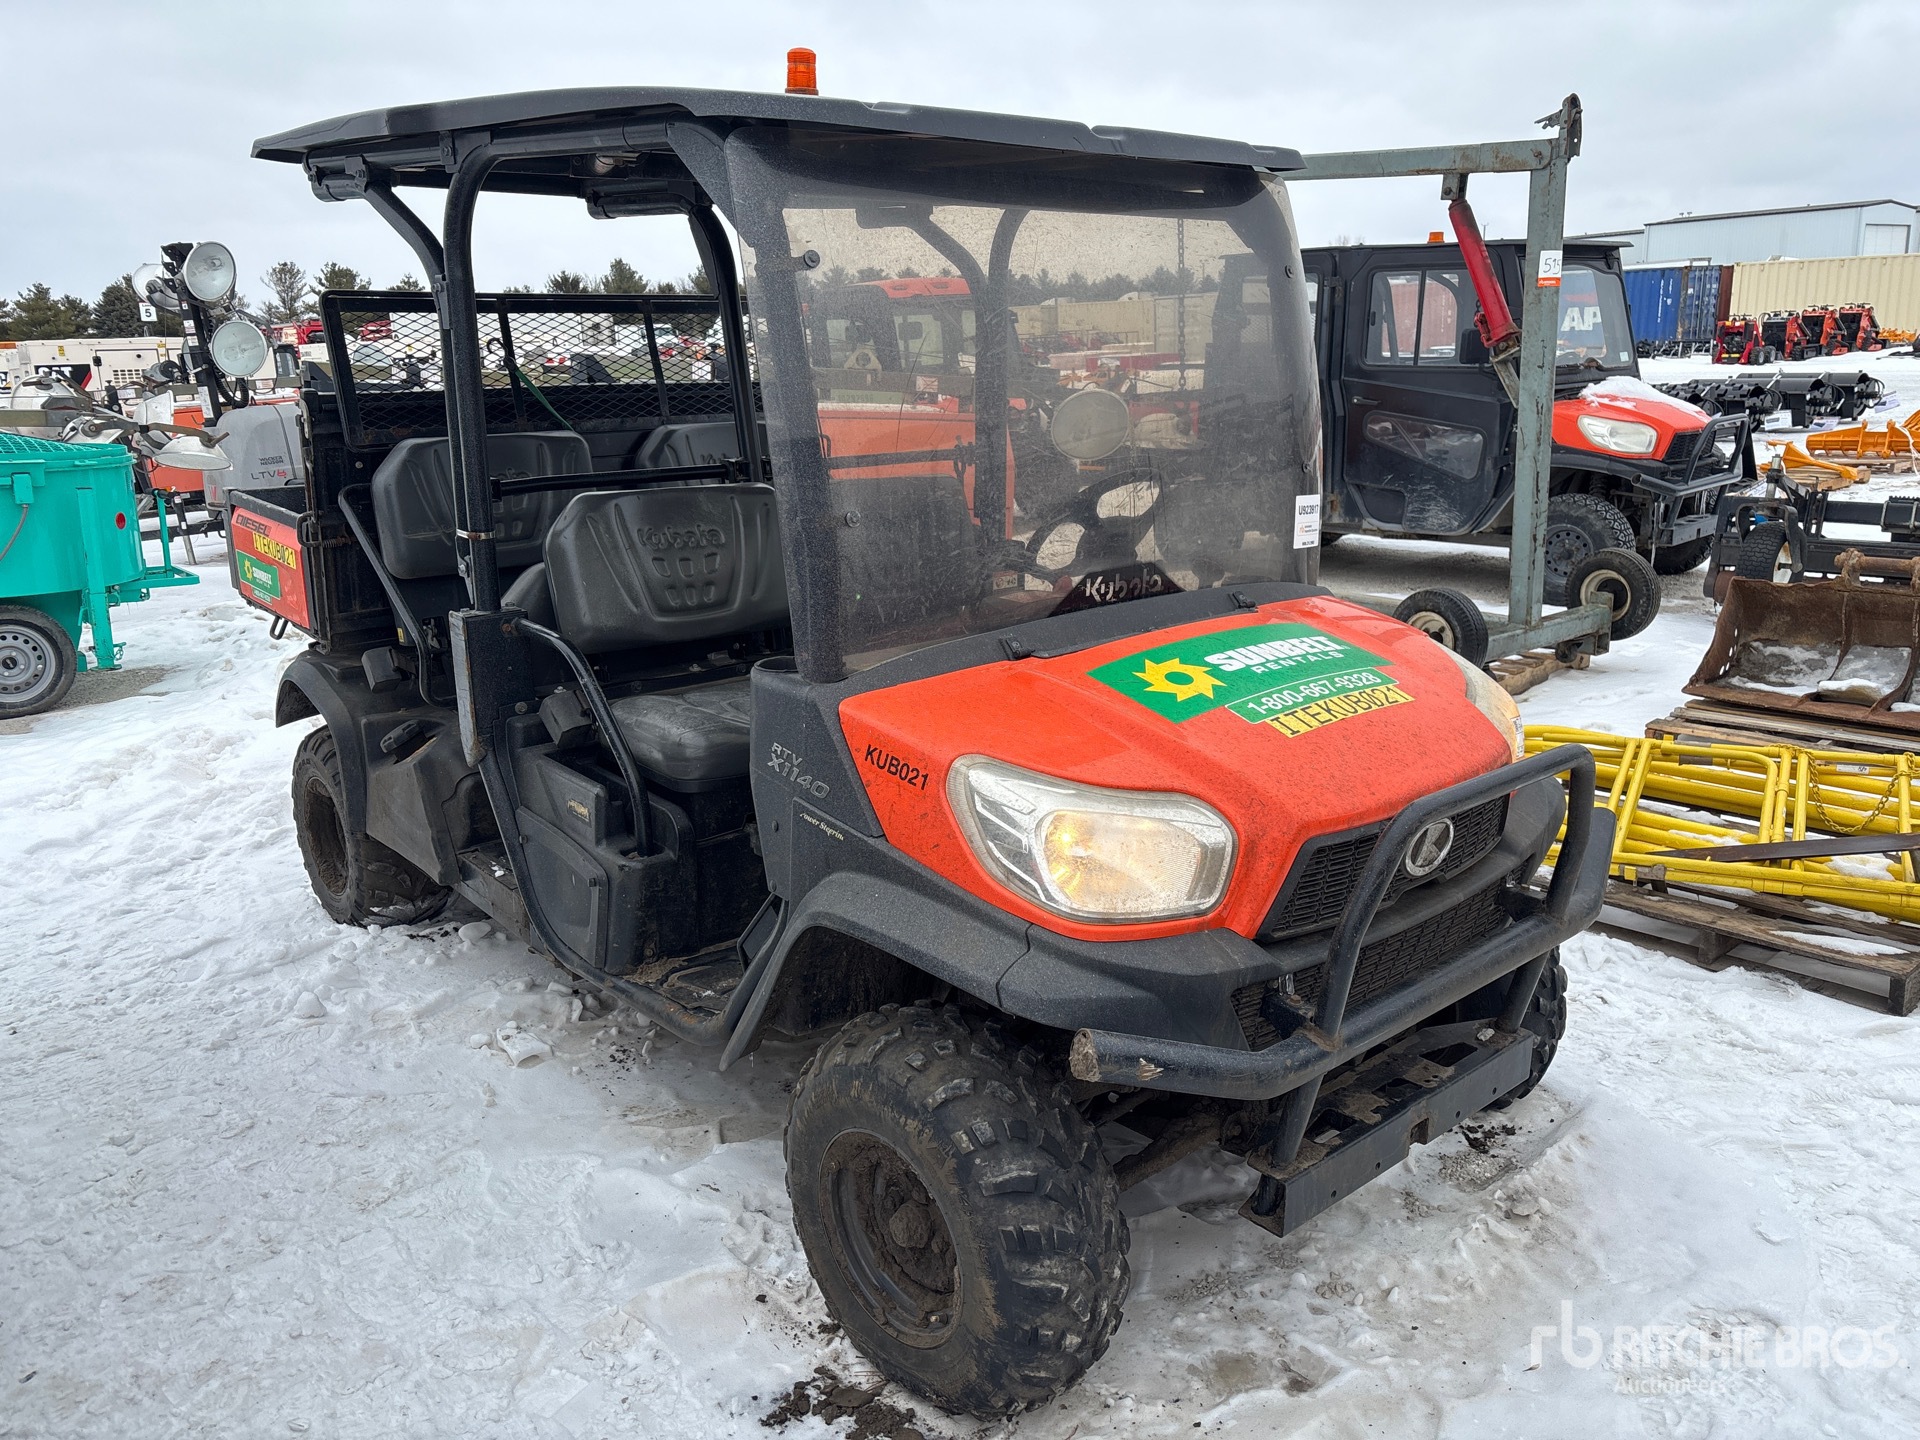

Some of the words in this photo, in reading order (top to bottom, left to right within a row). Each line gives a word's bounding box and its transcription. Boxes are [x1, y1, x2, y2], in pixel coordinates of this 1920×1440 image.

[145, 308, 152, 318] 5
[236, 514, 271, 537] DIESEL
[636, 523, 725, 551] Kubota
[1203, 635, 1345, 672] SUNBELT
[1250, 651, 1345, 674] RENTALS
[1247, 671, 1382, 715] 1-800-667-9328
[771, 742, 802, 766] RTV
[864, 743, 929, 791] KUB021
[767, 753, 830, 799] X1140
